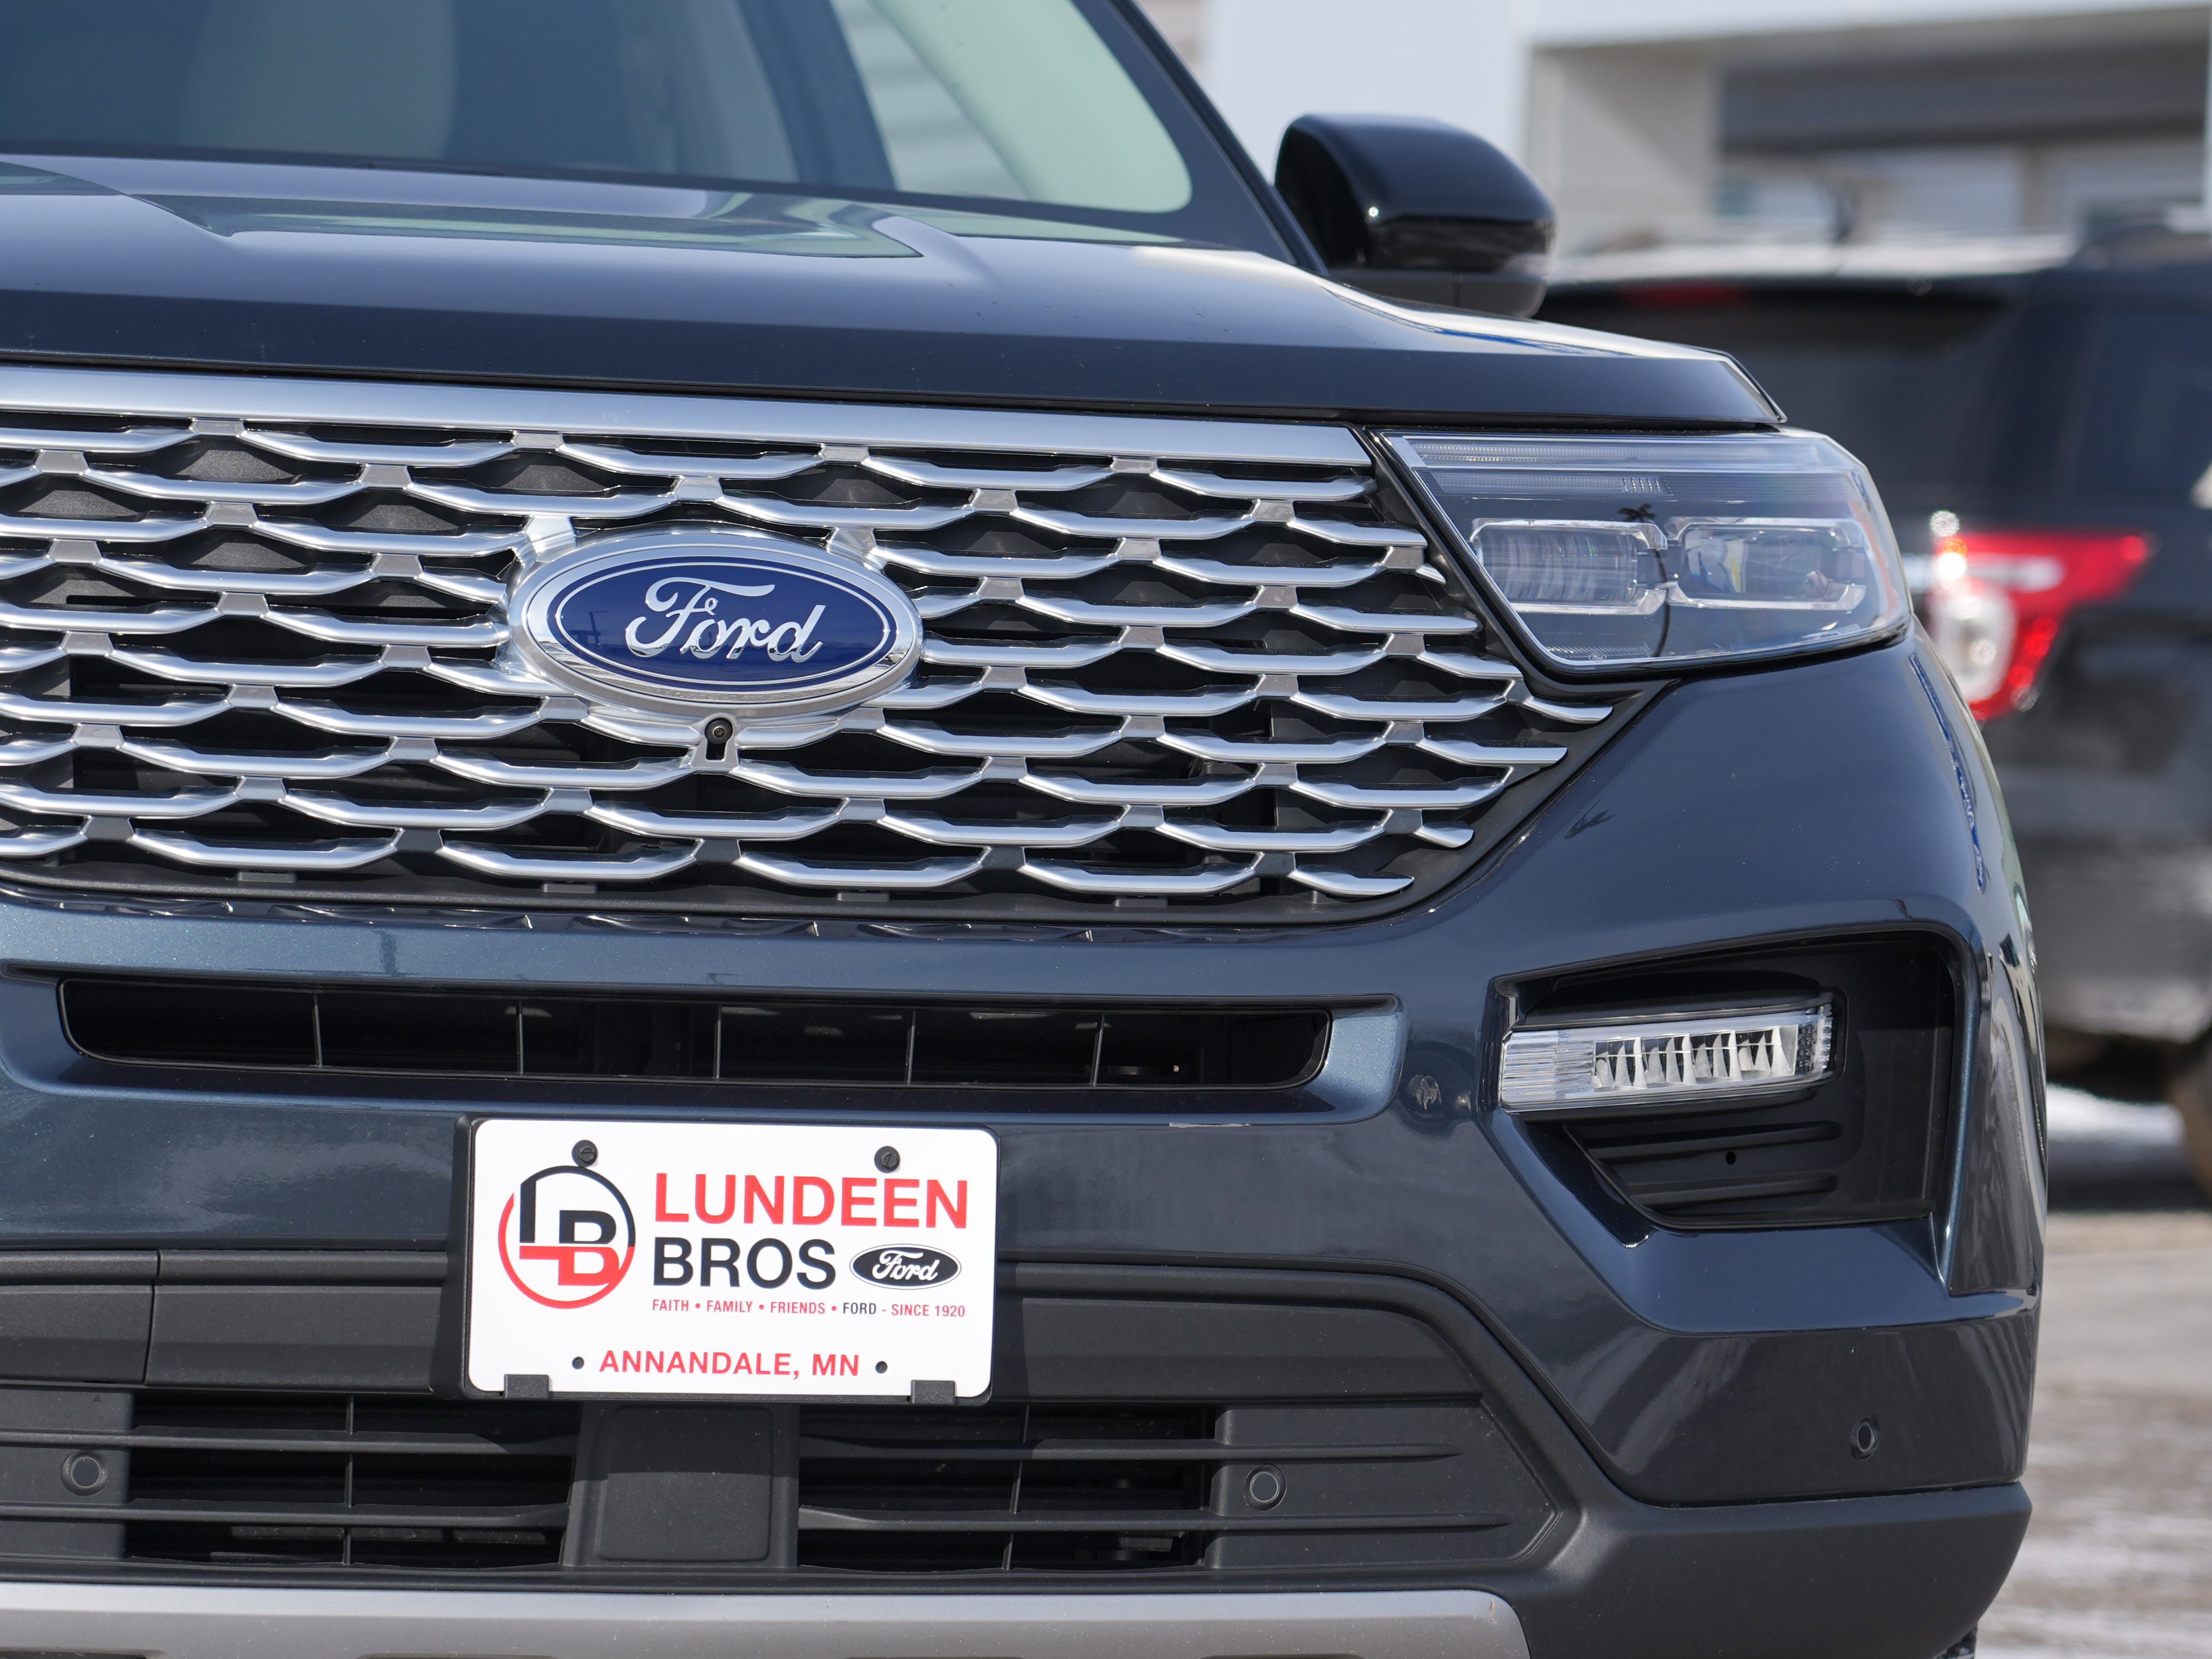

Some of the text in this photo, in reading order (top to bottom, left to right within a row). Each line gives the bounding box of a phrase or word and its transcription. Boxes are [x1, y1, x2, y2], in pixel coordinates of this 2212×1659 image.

[625, 576, 826, 663] Ford
[655, 1172, 967, 1229] LUNDEEN
[653, 1237, 836, 1290] BROS
[872, 1250, 941, 1281] Ford
[652, 1299, 690, 1311] FAITH
[706, 1300, 753, 1313] FAMILY
[770, 1301, 826, 1314] FRIENDS
[842, 1302, 876, 1315] FORD
[891, 1304, 929, 1316] SINCE
[935, 1305, 966, 1317] 1920
[599, 1350, 859, 1380] ANNANDALE, MN
